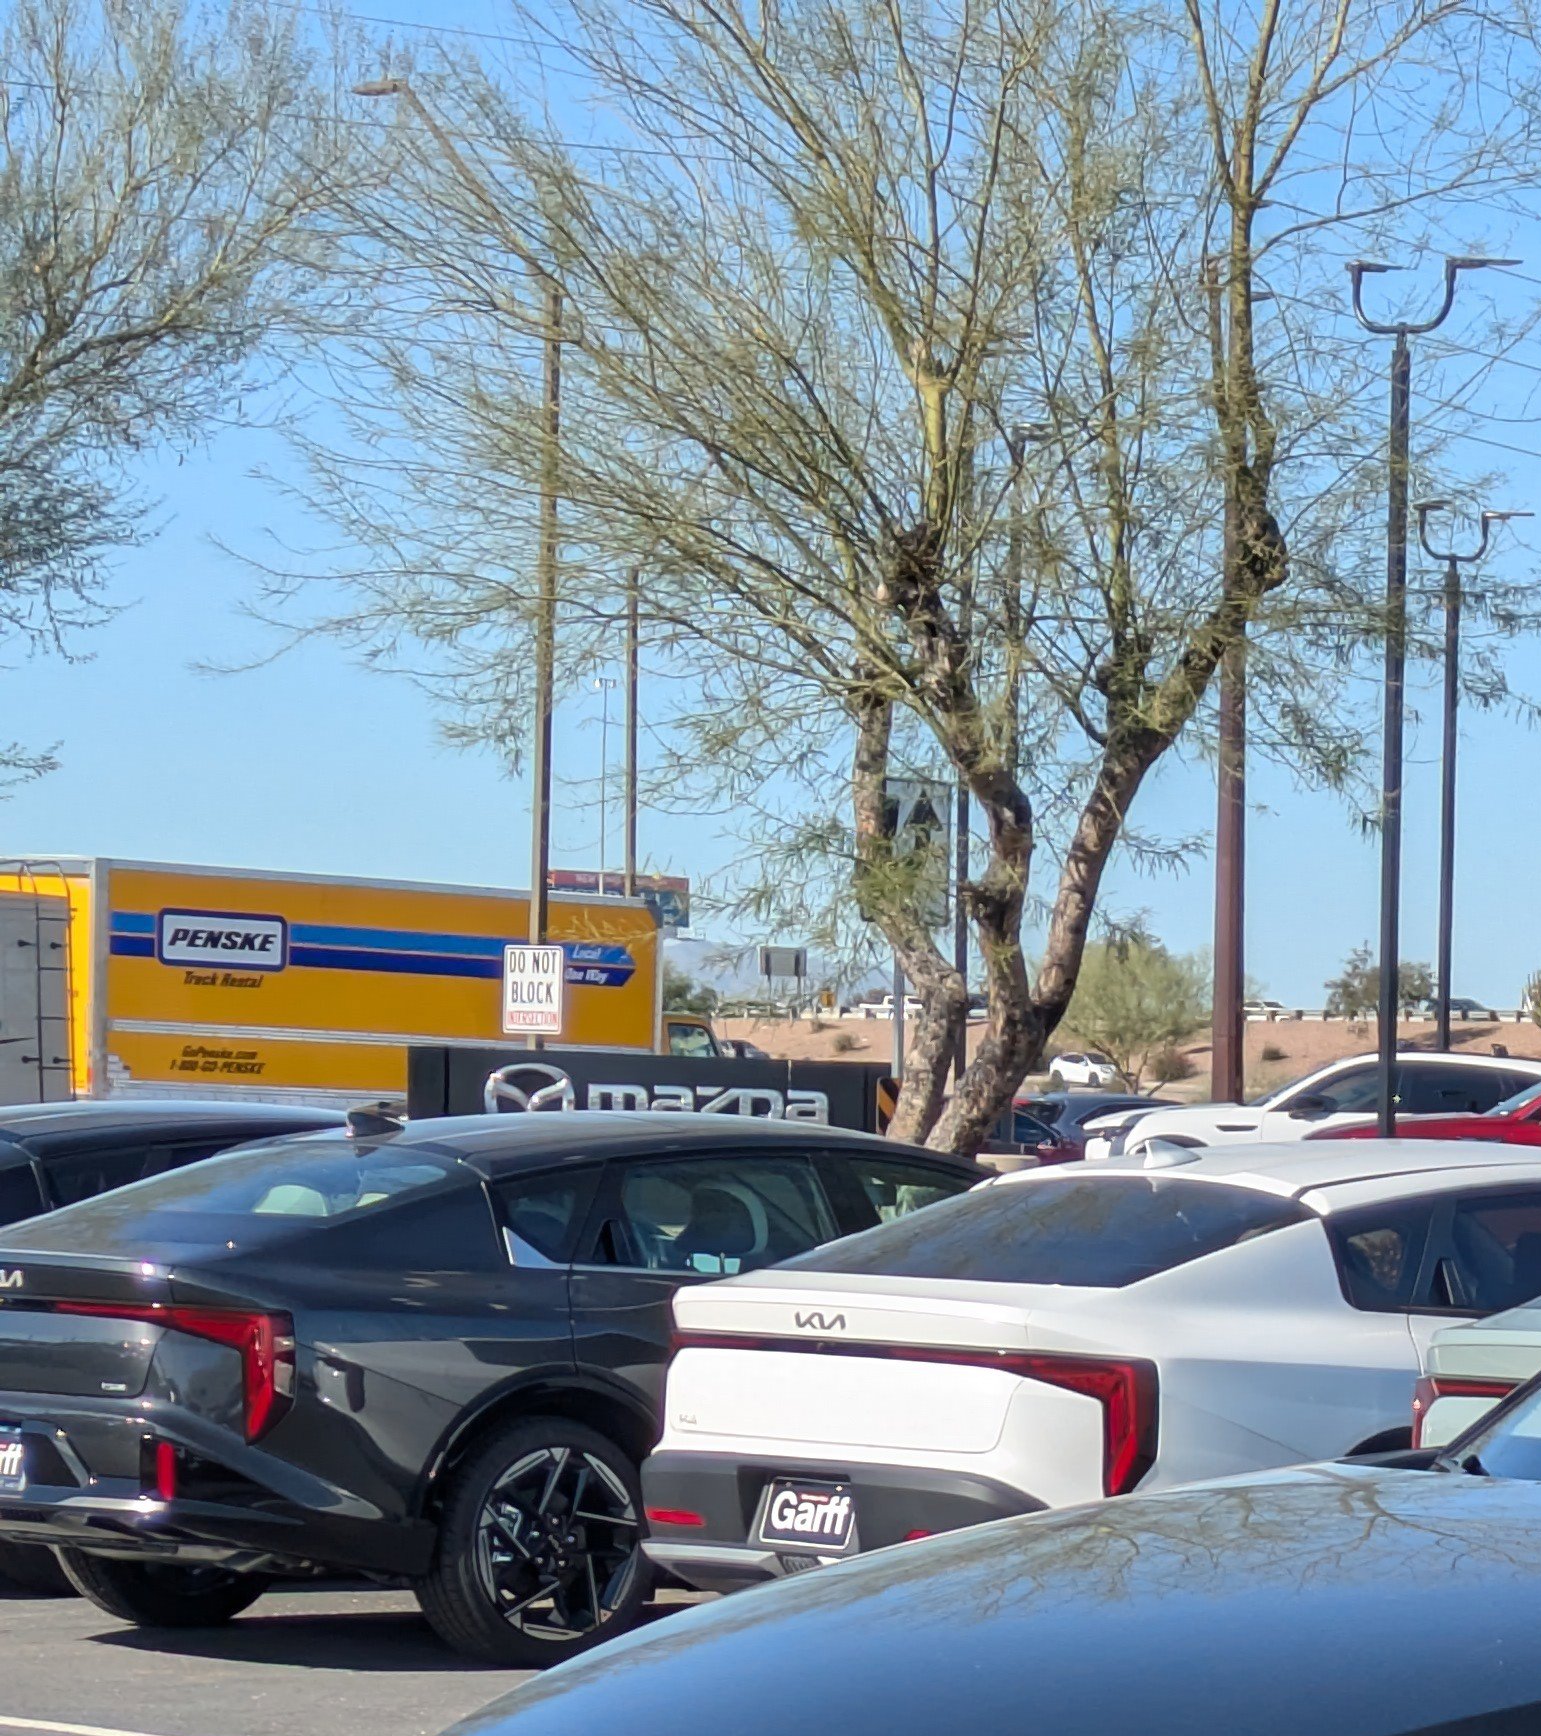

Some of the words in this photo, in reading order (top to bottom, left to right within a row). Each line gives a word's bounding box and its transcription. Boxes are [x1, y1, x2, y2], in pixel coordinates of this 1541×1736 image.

[168, 928, 278, 952] PENSKE
[509, 951, 526, 973] DO
[532, 951, 557, 974] NOT
[183, 971, 218, 986] Truck
[220, 973, 265, 988] Rental
[511, 981, 554, 1004] BLOCK
[771, 1490, 851, 1535] Garff
